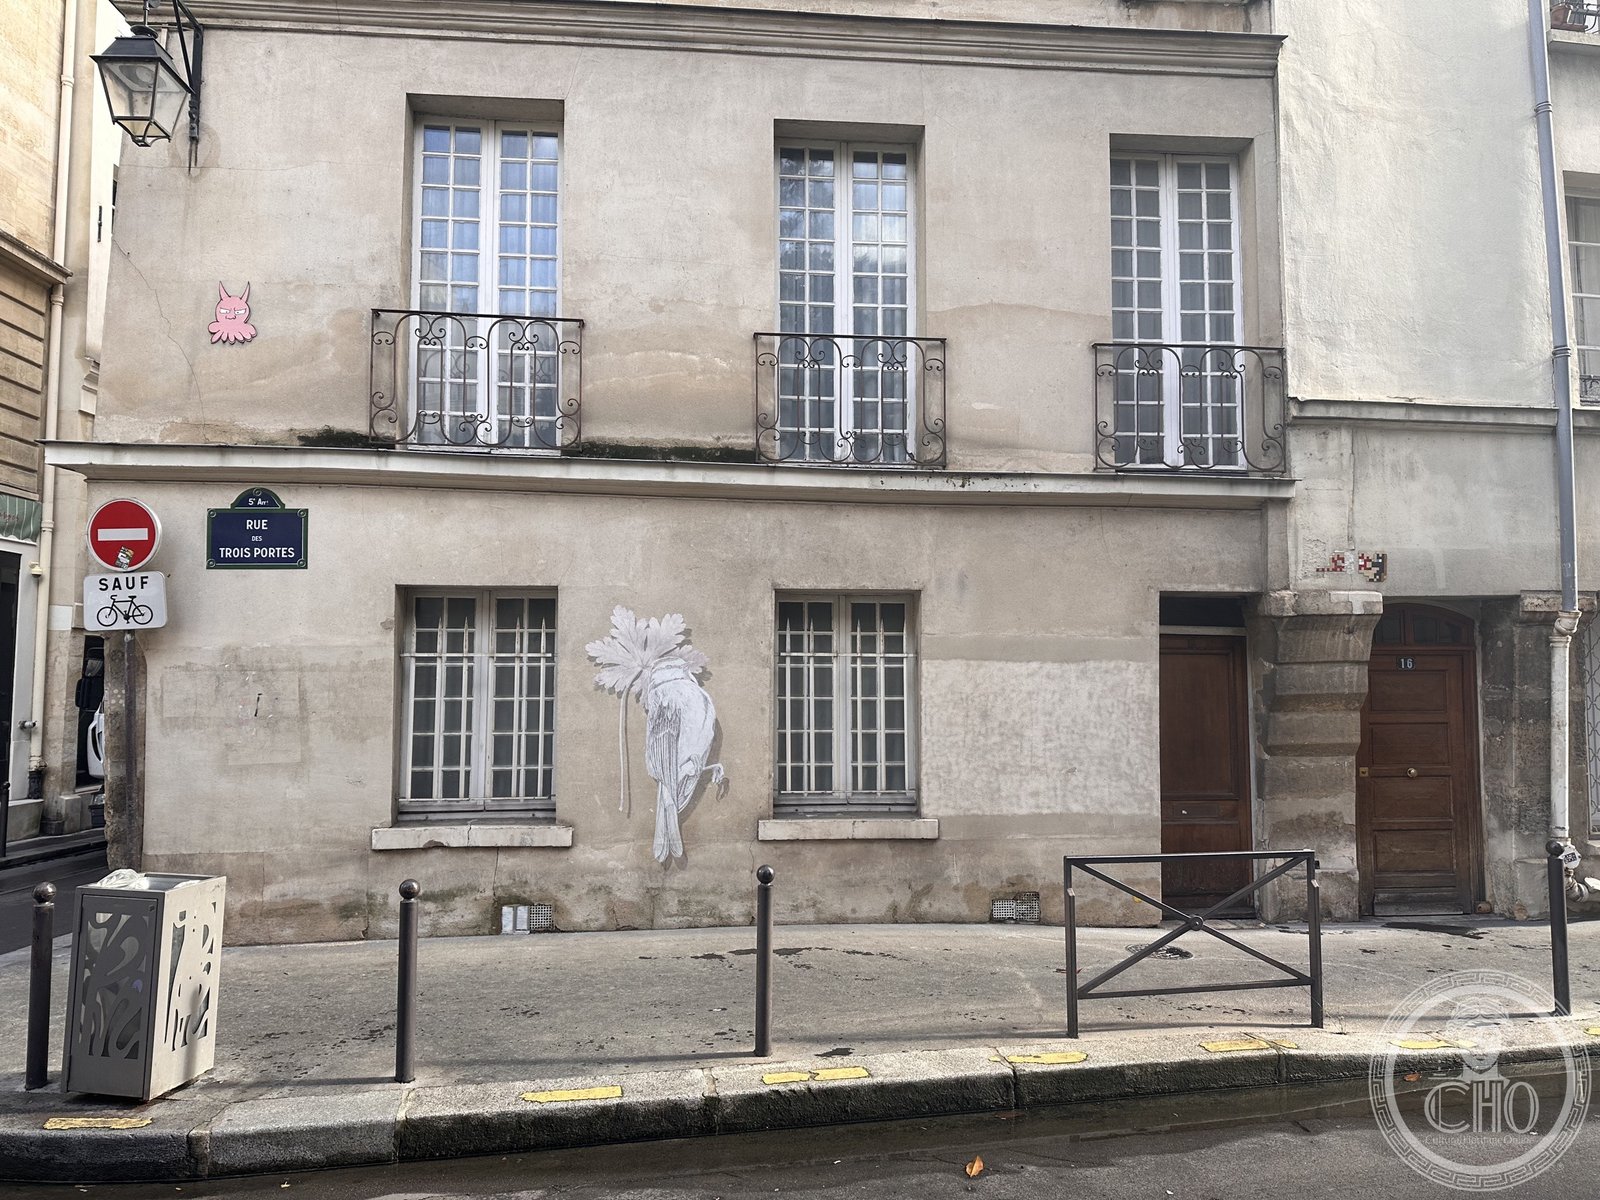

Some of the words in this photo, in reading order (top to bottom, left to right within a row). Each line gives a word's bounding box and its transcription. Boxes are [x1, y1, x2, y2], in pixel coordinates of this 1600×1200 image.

[246, 519, 268, 530] RUE
[219, 547, 251, 558] TROIS
[254, 547, 295, 558] PORTES
[98, 575, 149, 592] SAUF
[1400, 658, 1413, 669] 16
